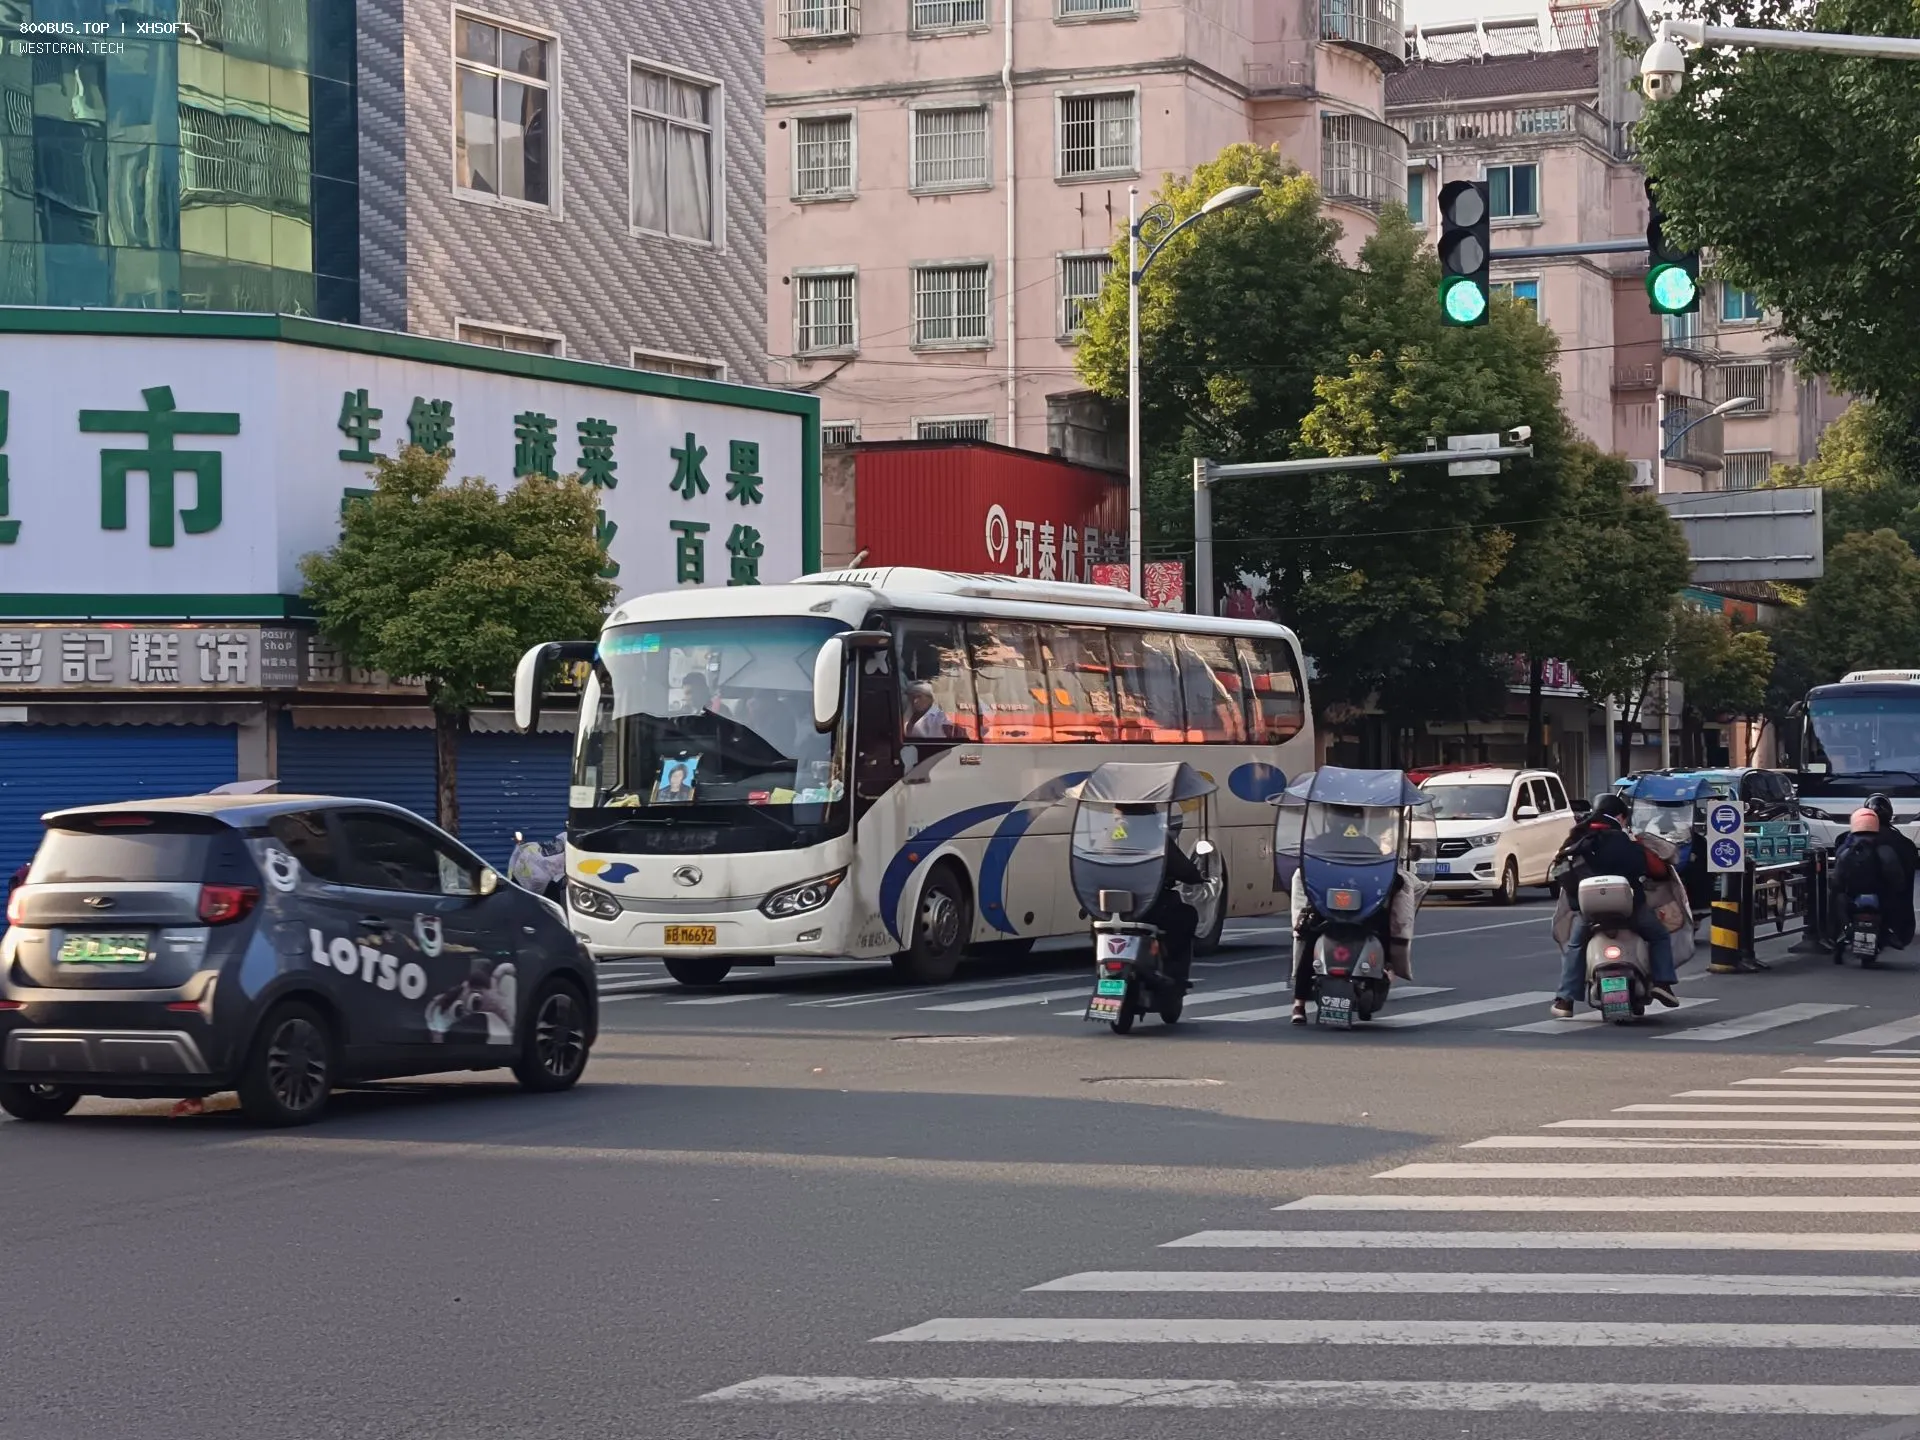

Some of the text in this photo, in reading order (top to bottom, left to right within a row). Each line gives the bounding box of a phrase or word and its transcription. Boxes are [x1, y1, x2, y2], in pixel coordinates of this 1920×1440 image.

[0, 385, 240, 547] 市
[338, 388, 764, 506] 生鲜 蔬菜 水果
[669, 520, 765, 586] 百货
[264, 640, 293, 650] shop
[309, 928, 428, 1000] LOTSO
